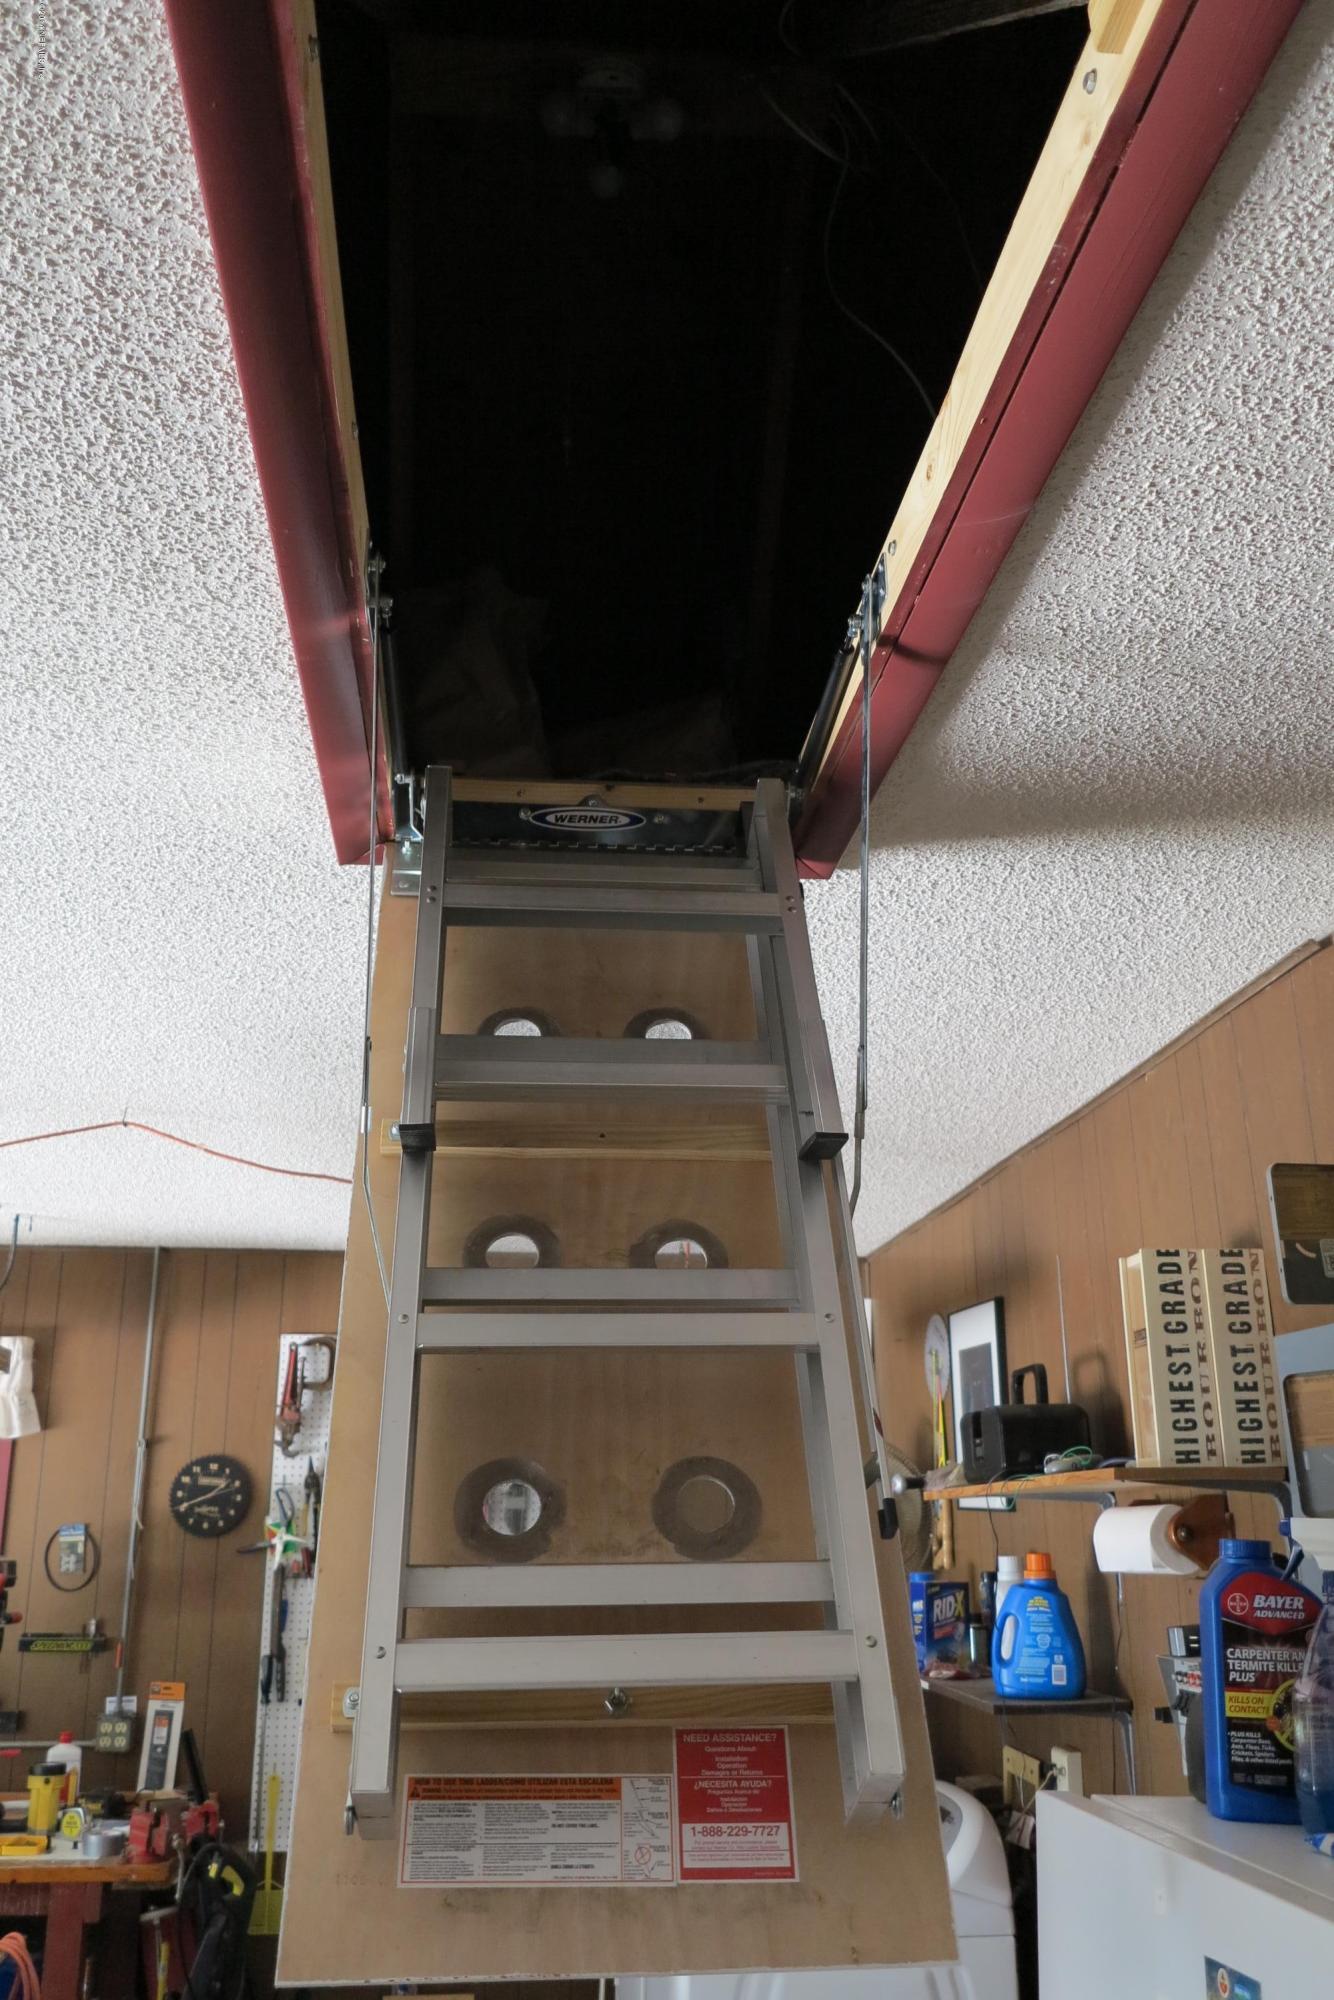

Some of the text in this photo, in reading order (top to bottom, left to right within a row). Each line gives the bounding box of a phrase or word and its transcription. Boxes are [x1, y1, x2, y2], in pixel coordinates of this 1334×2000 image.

[554, 814, 619, 824] WERNER
[1155, 1248, 1201, 1464] HIGHEST GRADE
[1219, 1248, 1266, 1464] HIGHEST GRADE
[1253, 1595, 1304, 1609] BAYER
[1254, 1610, 1305, 1620] ADVANCED
[1227, 1648, 1290, 1661] CARPENTER
[1228, 1660, 1274, 1672] TERMITE
[1229, 1672, 1255, 1682] PLUS
[1228, 1696, 1264, 1705] KILLS ON
[683, 1733, 777, 1743] NEED ASSISTANCE?
[693, 1780, 772, 1790] ¿NECESITA AYUDA?
[690, 1825, 780, 1837] 1-888-229-7727
